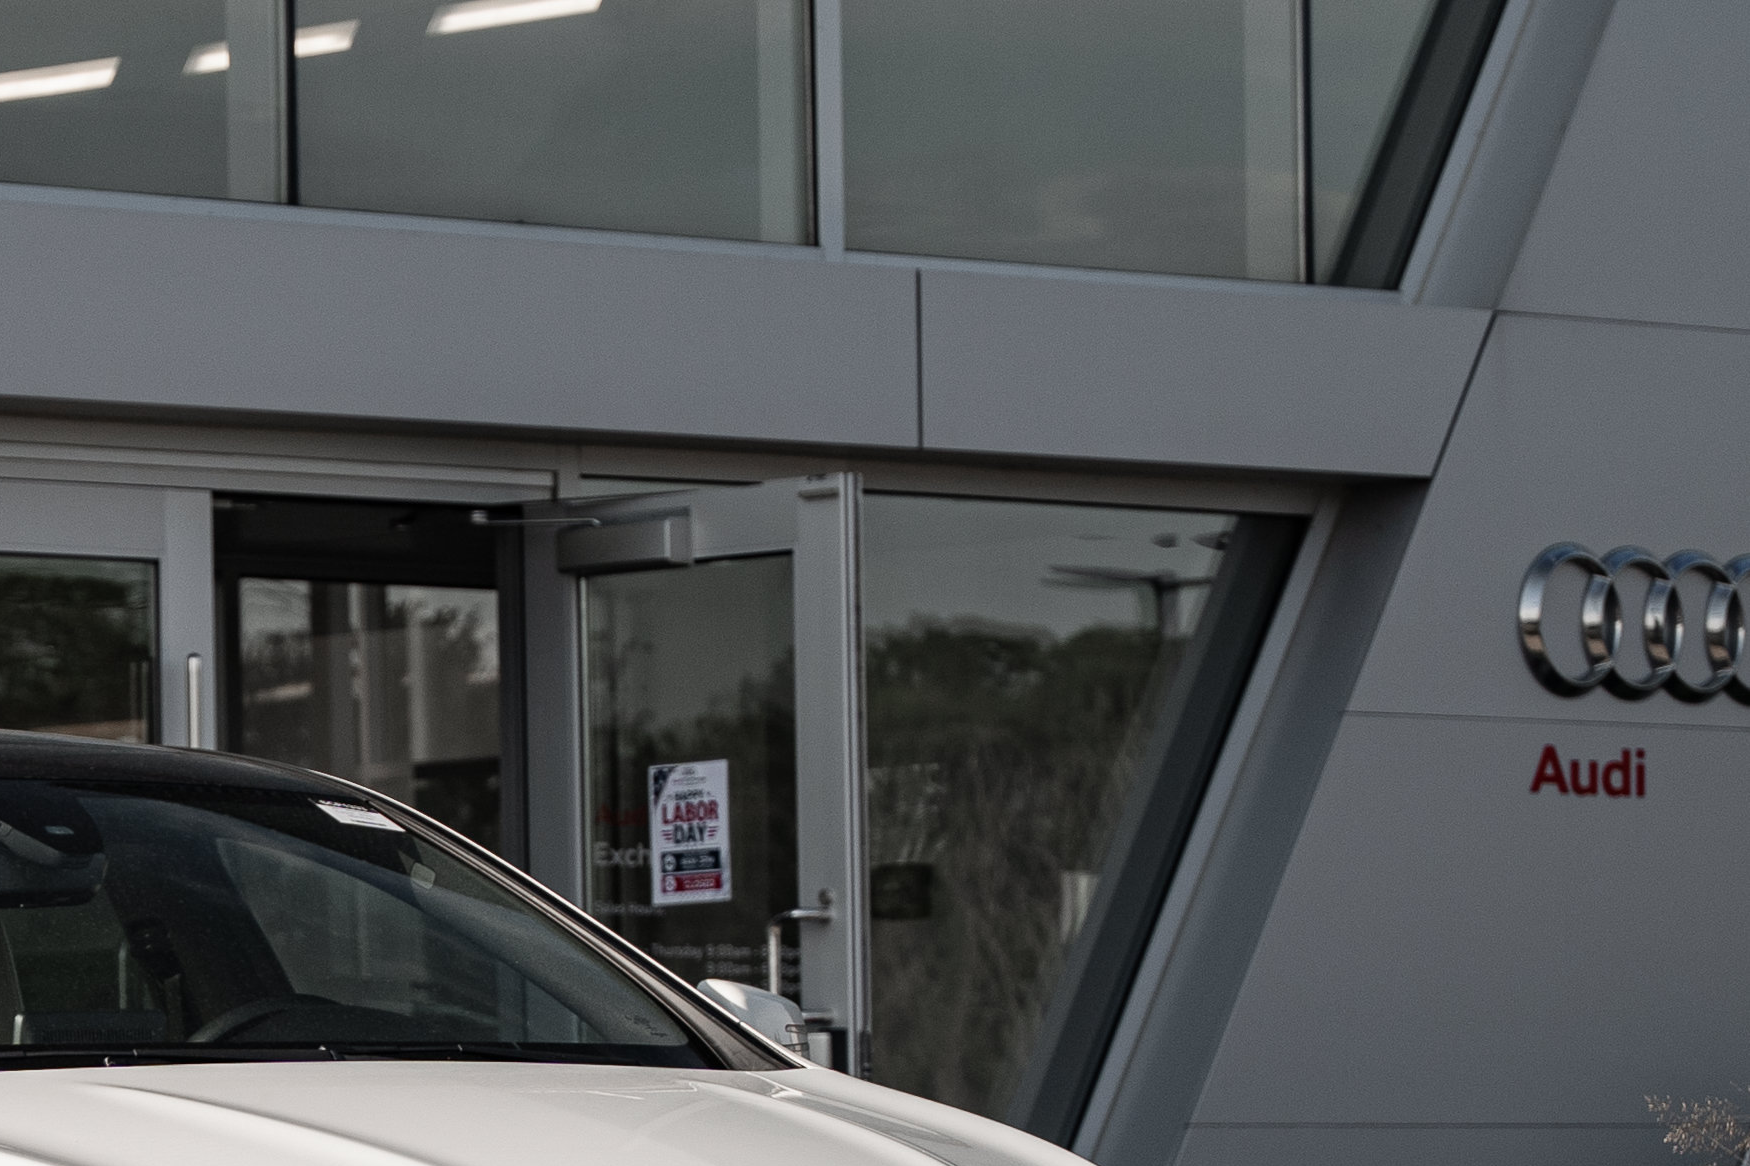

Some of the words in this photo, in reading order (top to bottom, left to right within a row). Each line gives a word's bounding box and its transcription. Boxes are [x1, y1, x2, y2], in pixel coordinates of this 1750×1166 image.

[1530, 744, 1646, 797] Audi
[661, 799, 719, 825] LABOR
[674, 822, 707, 845] DAY
